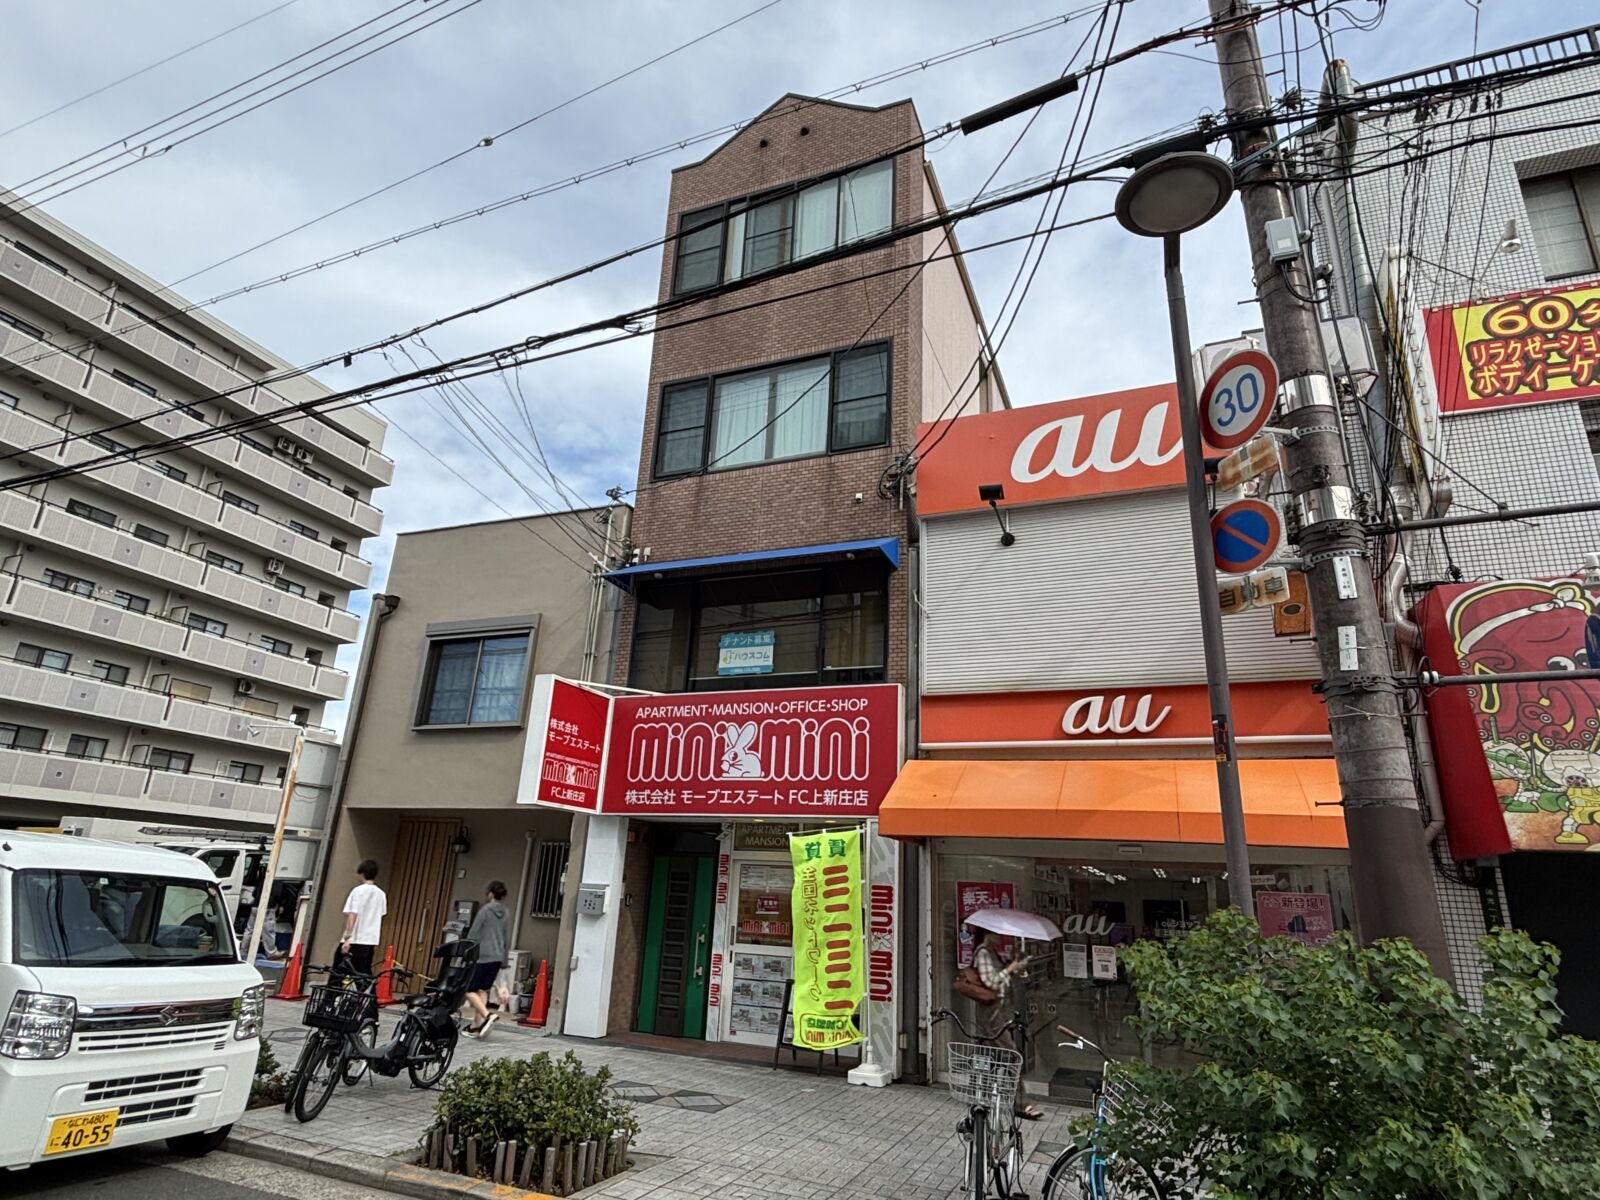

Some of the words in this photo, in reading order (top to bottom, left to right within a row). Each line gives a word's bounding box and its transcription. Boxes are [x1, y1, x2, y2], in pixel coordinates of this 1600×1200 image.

[1472, 330, 1600, 366] リラクゼーショ
[1476, 352, 1600, 394] ボディーケ
[1214, 371, 1260, 428] 30
[1010, 401, 1184, 483] au
[734, 651, 769, 661] ハウスコム
[549, 718, 579, 736] 株式会社
[1061, 694, 1172, 736] au
[627, 723, 729, 782] mini
[759, 717, 870, 781] mini
[543, 758, 569, 783] mini
[574, 765, 598, 790] mini
[625, 790, 676, 806] 株式会社
[681, 789, 785, 805] モーブエステート
[788, 788, 869, 807] FC上新庄店
[871, 885, 893, 934] mini
[1063, 914, 1115, 935] au
[870, 952, 893, 1003] mini
[50, 1136, 61, 1147] に
[61, 1124, 112, 1148] 40-55
